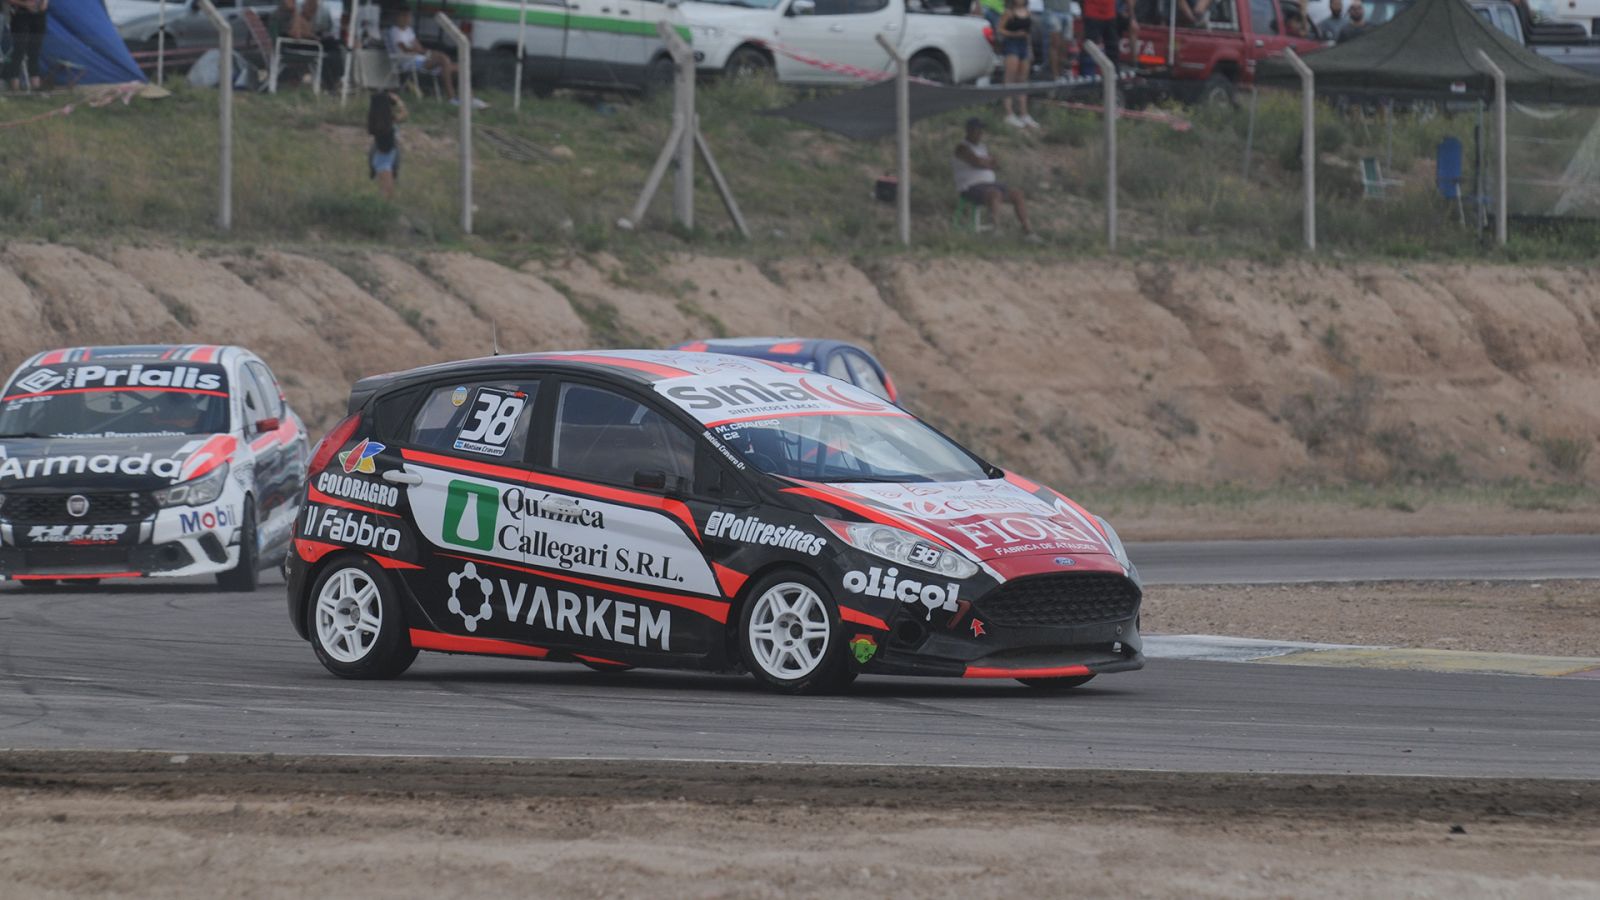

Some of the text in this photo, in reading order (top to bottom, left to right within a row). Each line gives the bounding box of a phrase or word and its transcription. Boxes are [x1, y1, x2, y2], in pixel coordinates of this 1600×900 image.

[73, 364, 221, 390] Prialis
[459, 393, 524, 445] 38
[715, 419, 780, 434] M. CRAVERO
[722, 431, 741, 441] C2
[0, 452, 182, 481] Armada
[318, 471, 399, 507] COLORAGRO
[180, 504, 236, 534] Mobil
[317, 509, 401, 552] Fabbro
[717, 513, 827, 556] Poliresinas
[499, 524, 685, 582] Callegari S.R.L.
[910, 544, 941, 565] 38
[994, 543, 1041, 556] FABRICA
[1040, 542, 1056, 550] DE
[843, 566, 961, 621] olicol
[499, 578, 672, 651] VARKEM
